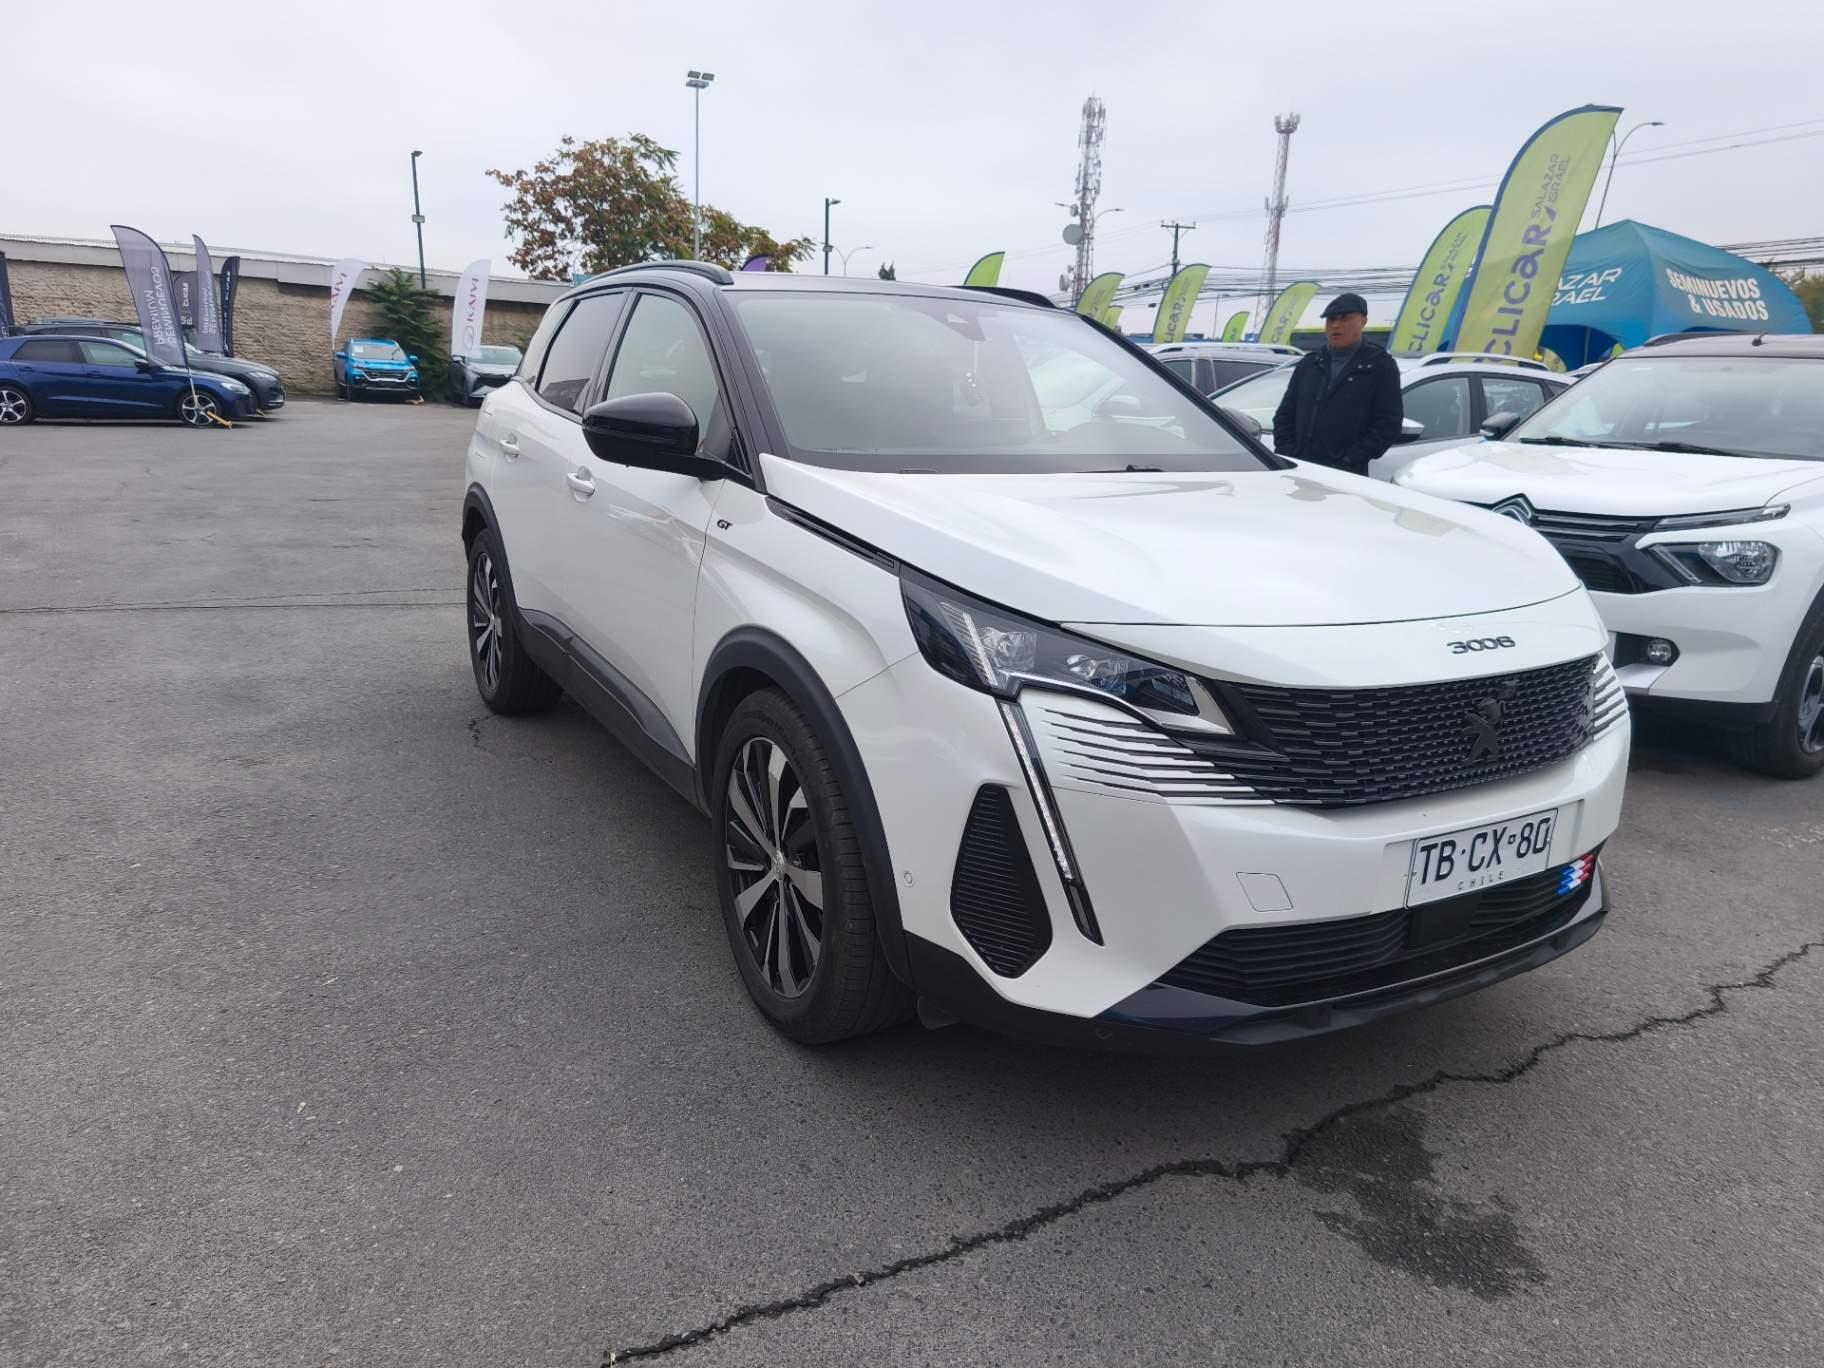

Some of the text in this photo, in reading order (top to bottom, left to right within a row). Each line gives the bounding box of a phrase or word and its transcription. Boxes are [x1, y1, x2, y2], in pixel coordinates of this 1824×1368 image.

[1666, 267, 1761, 299] SEMINUEVOS
[1688, 293, 1768, 320] & USADOS
[716, 519, 733, 531] GT
[1457, 870, 1504, 890] CHILE
